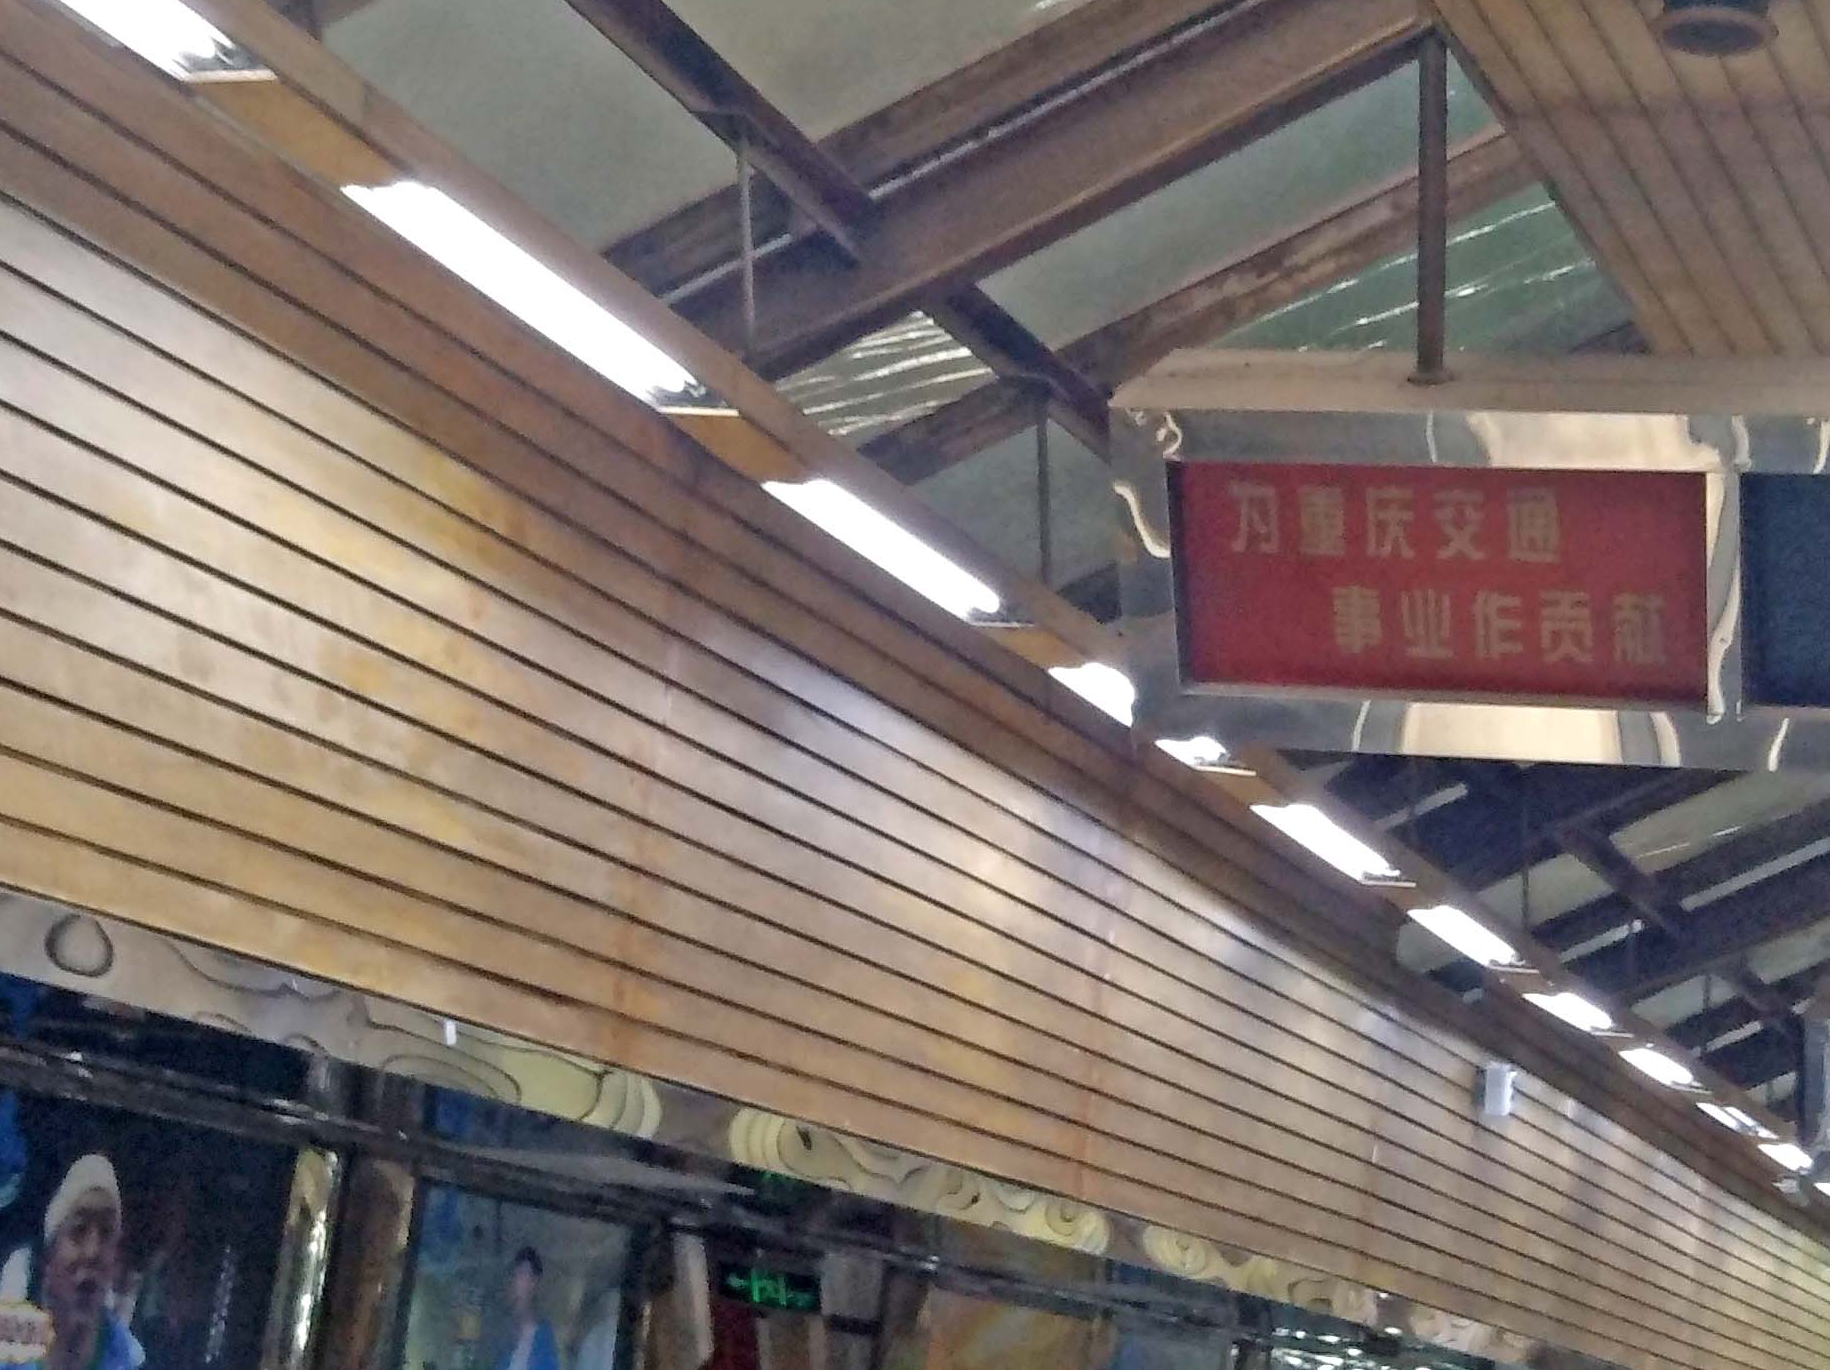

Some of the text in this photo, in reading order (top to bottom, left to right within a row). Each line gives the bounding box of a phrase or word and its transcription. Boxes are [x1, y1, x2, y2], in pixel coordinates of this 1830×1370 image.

[1227, 479, 1561, 563] 为重庆交通
[1331, 585, 1667, 665] 事业作贡献
